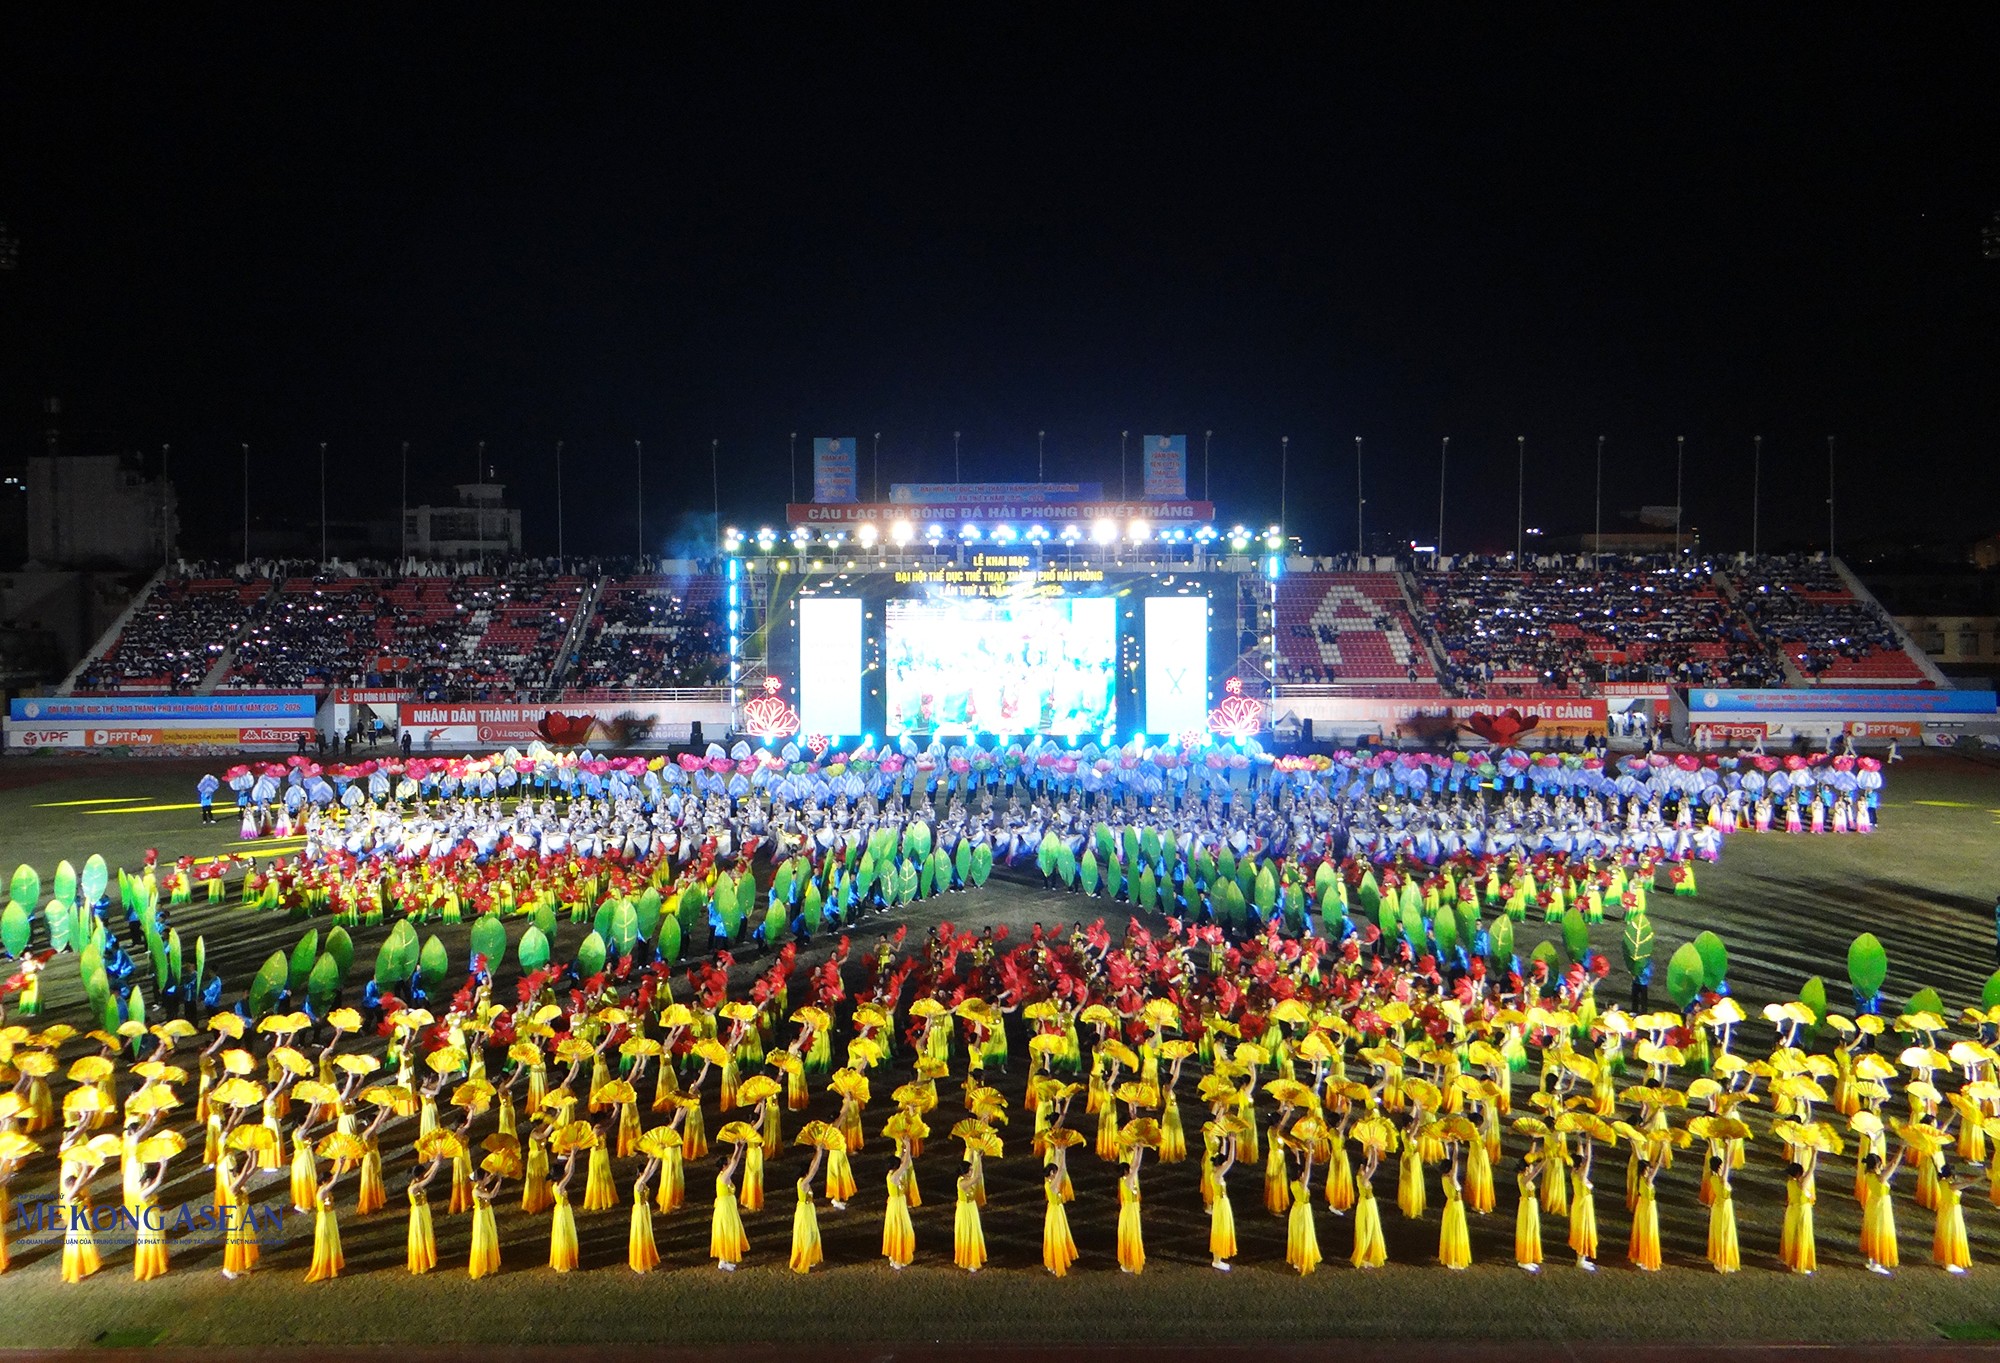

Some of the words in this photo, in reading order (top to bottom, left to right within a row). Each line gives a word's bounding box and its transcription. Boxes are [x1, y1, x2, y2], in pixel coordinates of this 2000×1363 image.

[808, 507, 842, 520] CÂU
[912, 505, 956, 519] BÓNG
[961, 505, 983, 518] ĐÁ
[988, 504, 1016, 518] HẢI
[1021, 504, 1077, 518] PHÒNG
[1140, 503, 1194, 518] THẮNG
[986, 556, 1007, 567] KHAI
[1008, 556, 1030, 569] MẠC
[895, 572, 911, 584] ĐẠI
[912, 570, 927, 584] HỘI
[928, 568, 945, 582] THỂ
[946, 572, 964, 584] DỤC
[965, 568, 982, 582] THỂ
[983, 572, 1006, 582] THAO
[1037, 568, 1056, 582] PHỐ
[1057, 568, 1073, 582] HẢI
[1073, 569, 1104, 582] PHÒNG
[353, 692, 363, 702] CLB
[262, 703, 279, 712] 2025
[1526, 701, 1553, 719] ĐẤT
[1556, 701, 1593, 719] CẢNG
[413, 707, 448, 723] NHÂN
[451, 707, 476, 723] DÂN
[479, 707, 519, 723] THÀNH
[1867, 725, 1887, 735] FPT
[1888, 724, 1911, 735] Play
[39, 731, 69, 742] VPF
[109, 732, 129, 742] FPT
[131, 732, 153, 744] Play
[260, 730, 310, 742] Kappa
